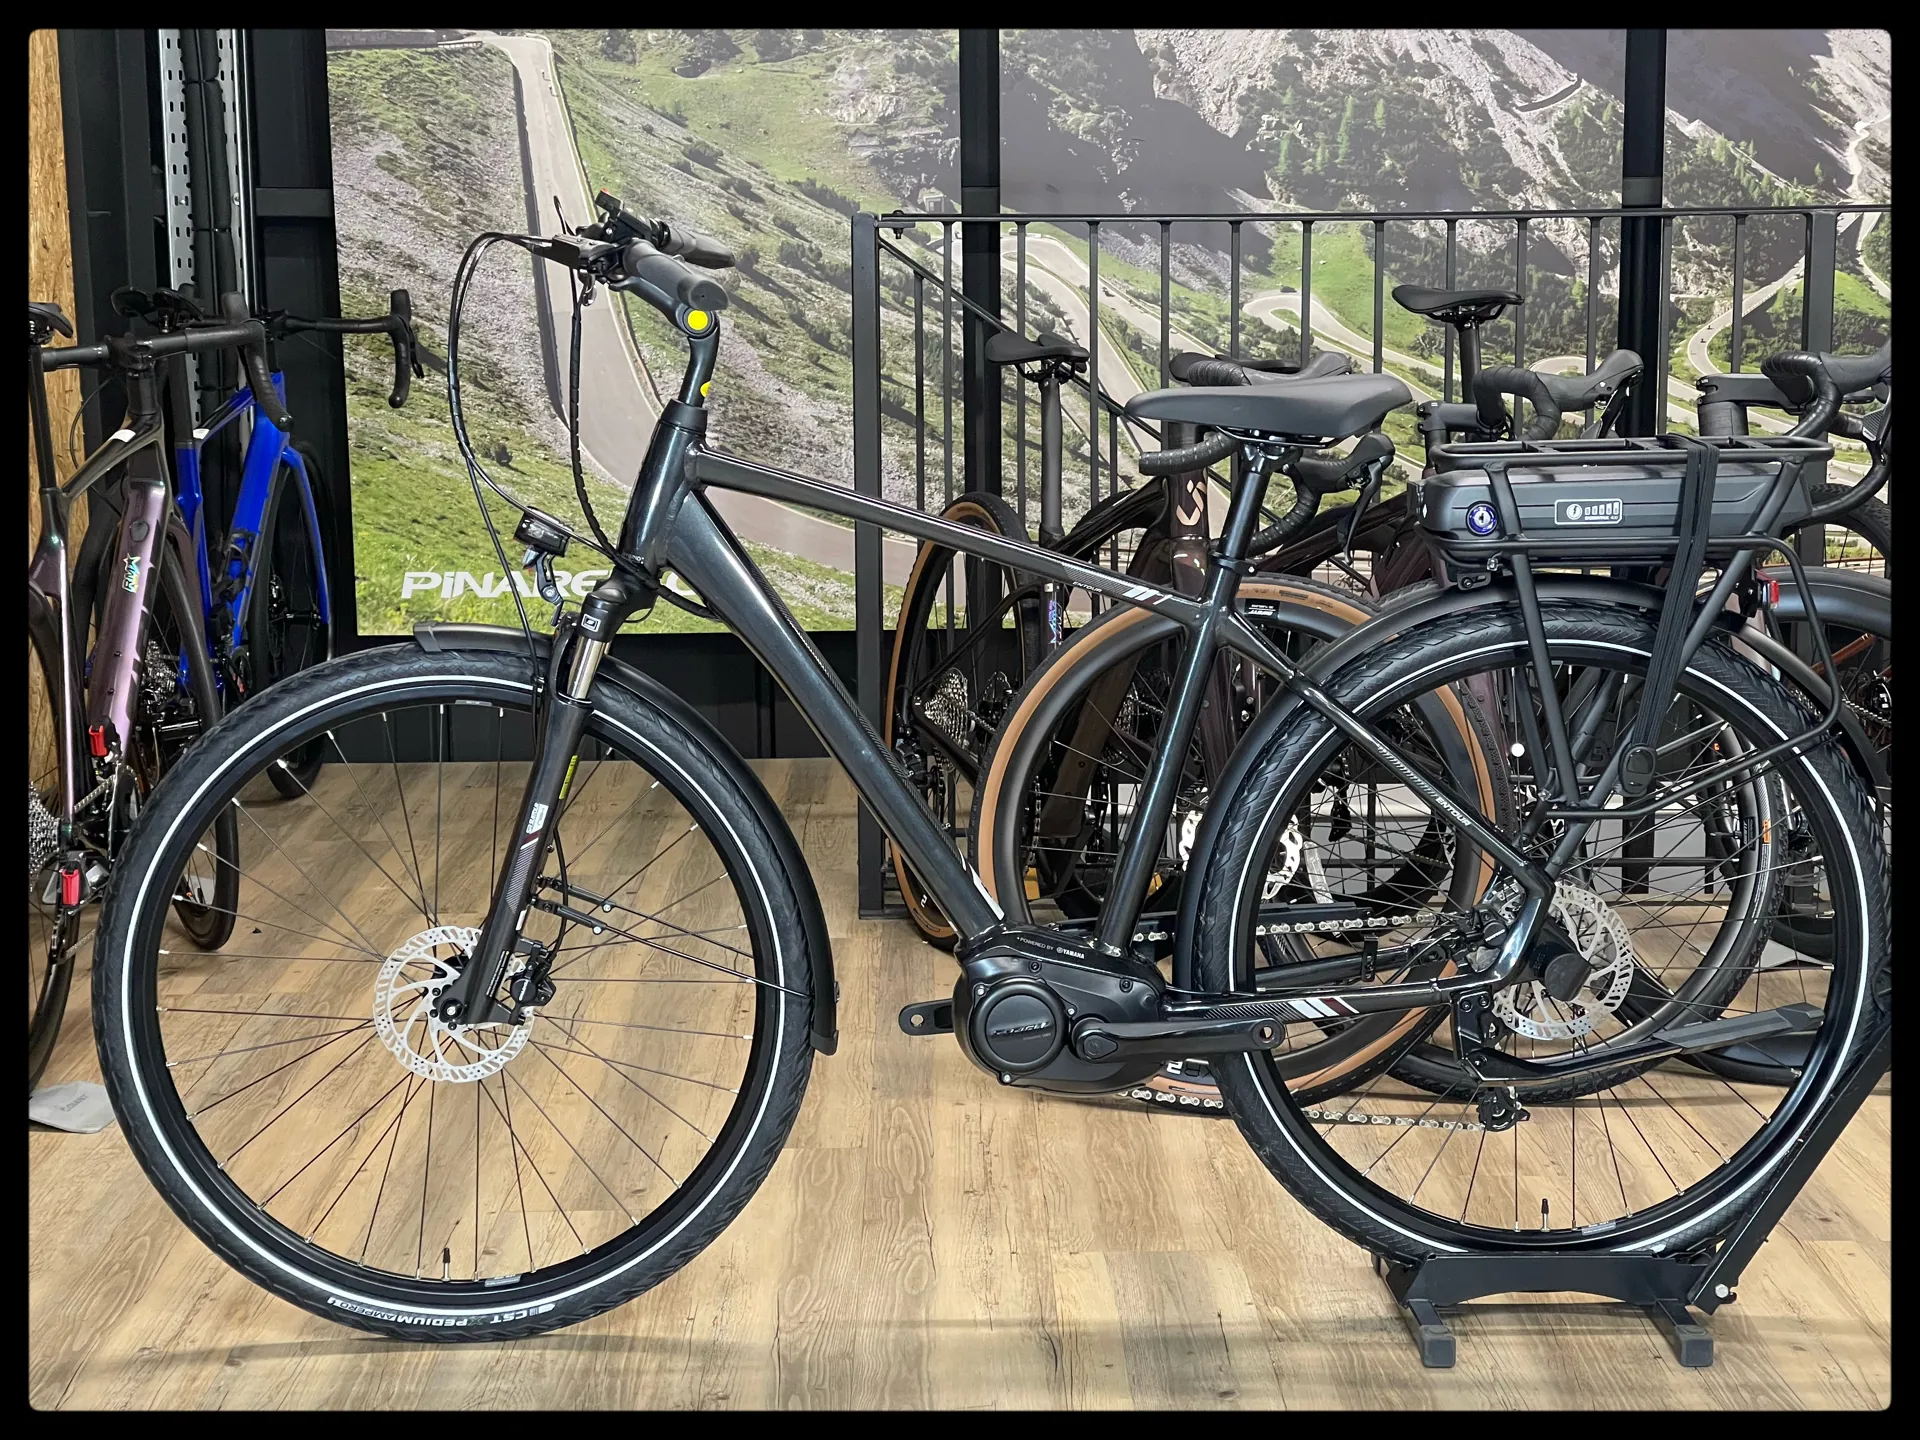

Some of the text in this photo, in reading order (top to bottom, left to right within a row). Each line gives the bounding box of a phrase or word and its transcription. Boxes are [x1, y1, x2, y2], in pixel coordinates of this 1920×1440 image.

[1072, 581, 1103, 593] ENTOUR
[1435, 797, 1472, 827] ENTOUR
[490, 1309, 531, 1324] CST
